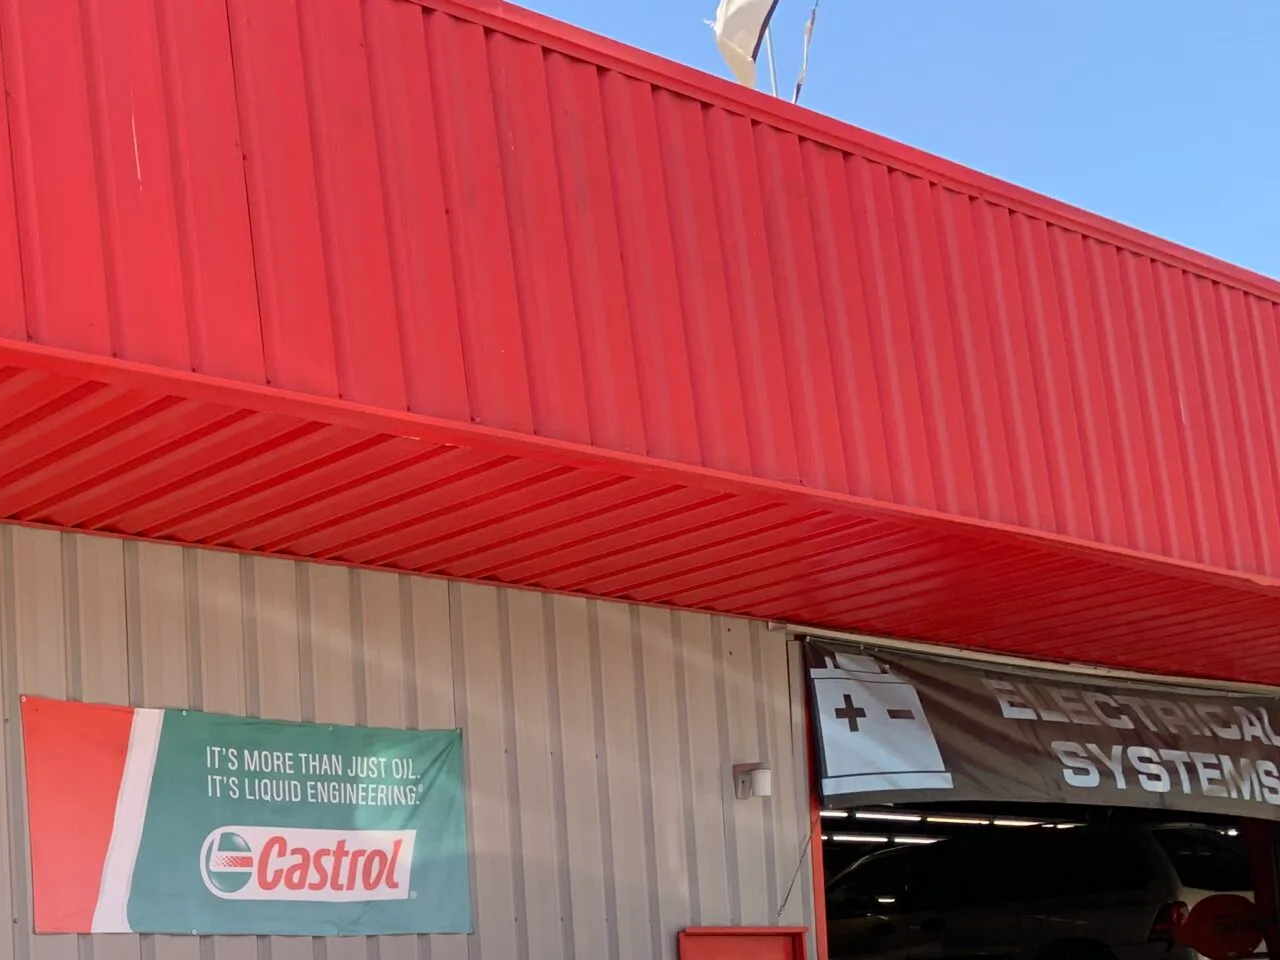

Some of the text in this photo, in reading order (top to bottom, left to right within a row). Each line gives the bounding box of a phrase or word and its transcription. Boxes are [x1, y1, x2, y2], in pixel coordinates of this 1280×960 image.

[981, 679, 1280, 746] ELECTRICAL
[206, 746, 238, 770] IT'S
[243, 750, 295, 774] MORE
[298, 753, 343, 775] THAN
[347, 756, 387, 778] JUST
[207, 775, 239, 799] IT'S
[244, 777, 301, 802] LIQUID
[1051, 740, 1280, 804] SYSTEMS
[257, 835, 403, 892] Castrol
